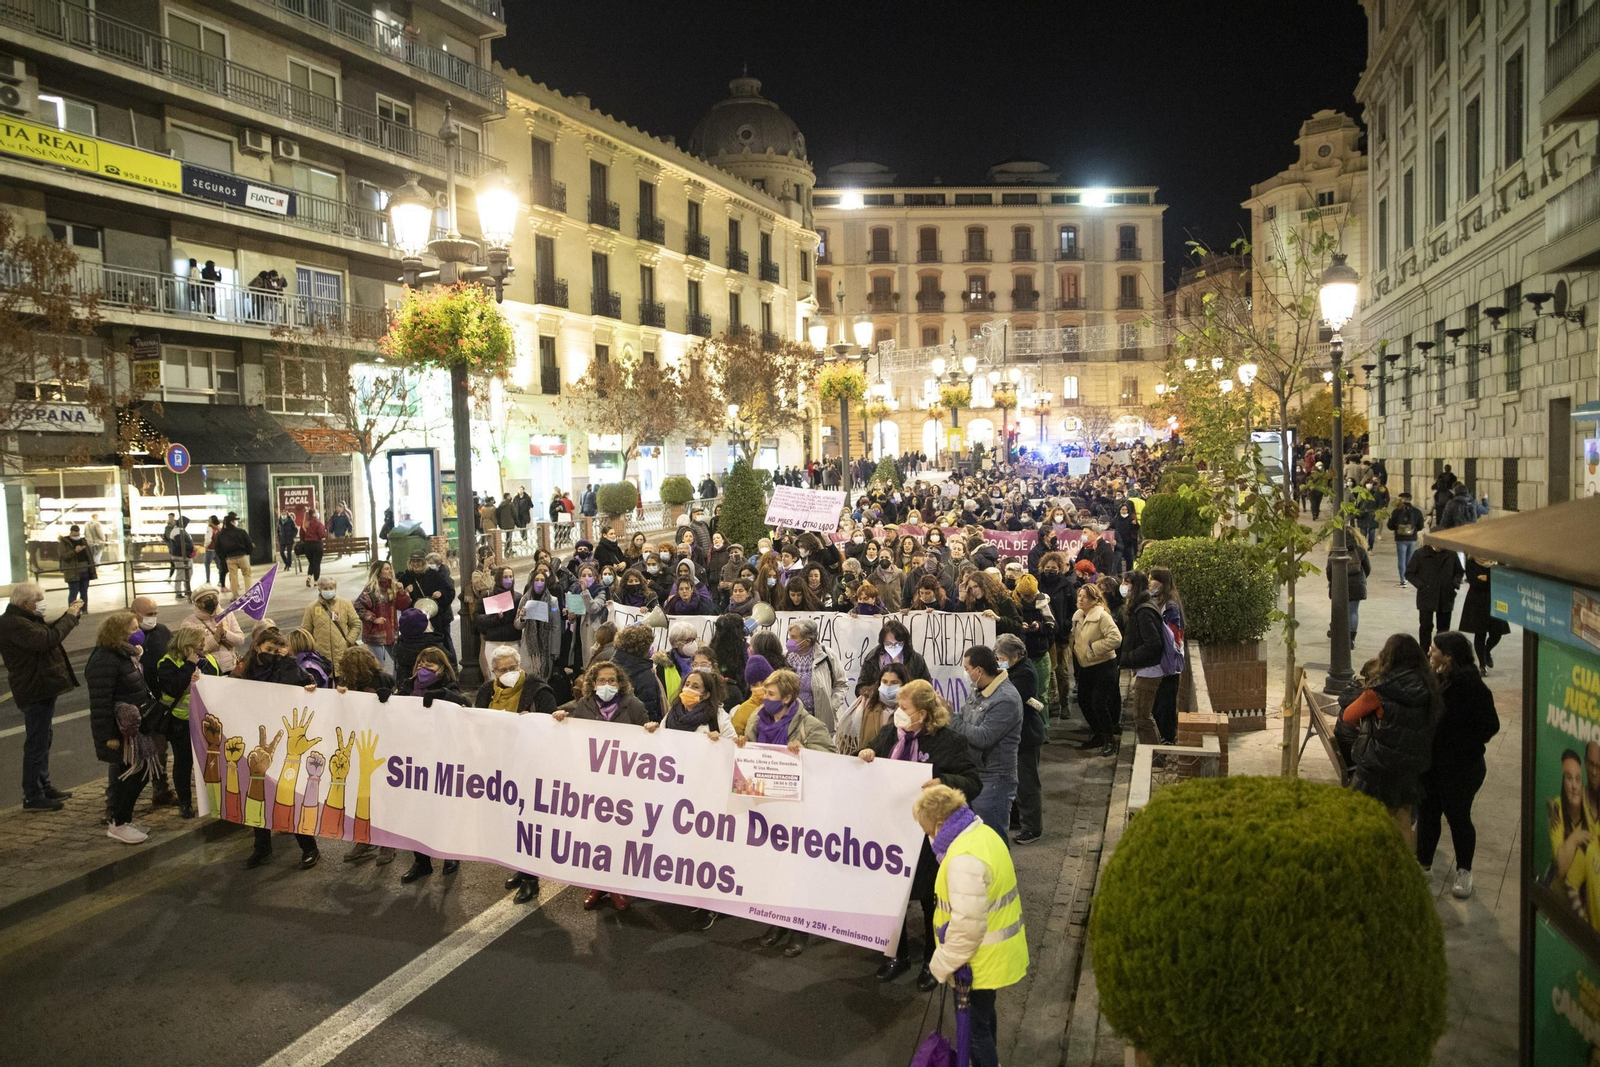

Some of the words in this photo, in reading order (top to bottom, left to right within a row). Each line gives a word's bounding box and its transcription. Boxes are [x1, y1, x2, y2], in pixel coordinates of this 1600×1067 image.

[0, 123, 30, 142] TA
[38, 132, 89, 156] REAL
[19, 143, 90, 167] ENSEÑANZA
[123, 171, 140, 181] 958
[142, 175, 159, 185] 261
[162, 179, 178, 190] 159
[192, 178, 237, 197] SEGUROS
[250, 192, 275, 206] FIATC
[285, 497, 309, 505] LOCAL
[802, 520, 818, 529] OTRO
[1013, 539, 1028, 551] DE
[1564, 686, 1600, 721] JUEG
[589, 737, 685, 785] Vivas.
[387, 755, 428, 792] Sin
[434, 761, 526, 816] Miedo,
[533, 777, 633, 826] Libres
[642, 802, 664, 838] y
[672, 798, 737, 843] Con
[746, 809, 912, 878] Derechos.
[516, 820, 543, 859] Ni
[551, 828, 612, 873] Una
[622, 840, 744, 896] Menos.
[749, 906, 791, 923] Plataforma
[792, 916, 805, 926] 8M
[805, 920, 811, 929] y
[812, 920, 828, 932] 25N
[832, 925, 873, 943] Feminismo
[875, 935, 890, 947] Uni
